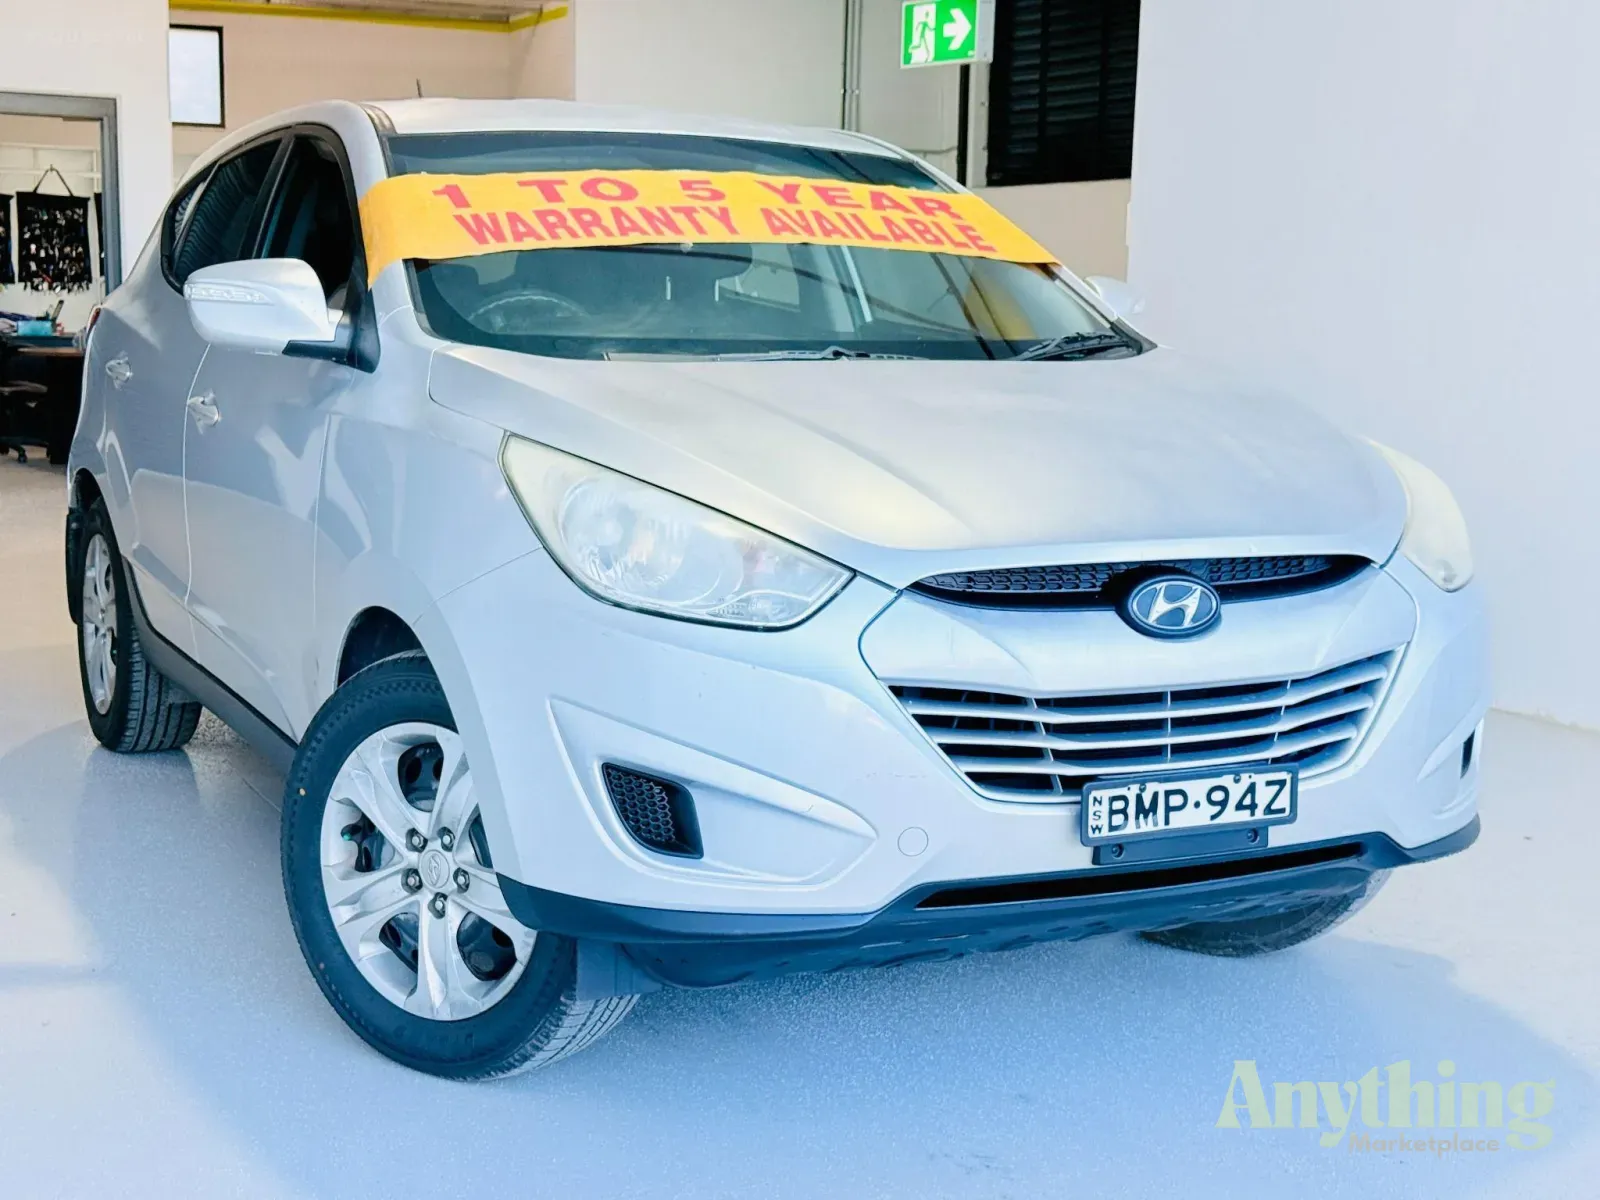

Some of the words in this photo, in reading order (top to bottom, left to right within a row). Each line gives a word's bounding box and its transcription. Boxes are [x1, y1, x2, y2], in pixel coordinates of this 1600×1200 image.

[432, 184, 472, 208] 1
[517, 177, 639, 203] TO
[679, 179, 726, 201] 5
[754, 180, 963, 220] YEAR
[452, 206, 740, 245] WARRANTY
[760, 207, 997, 252] AVAILABLE
